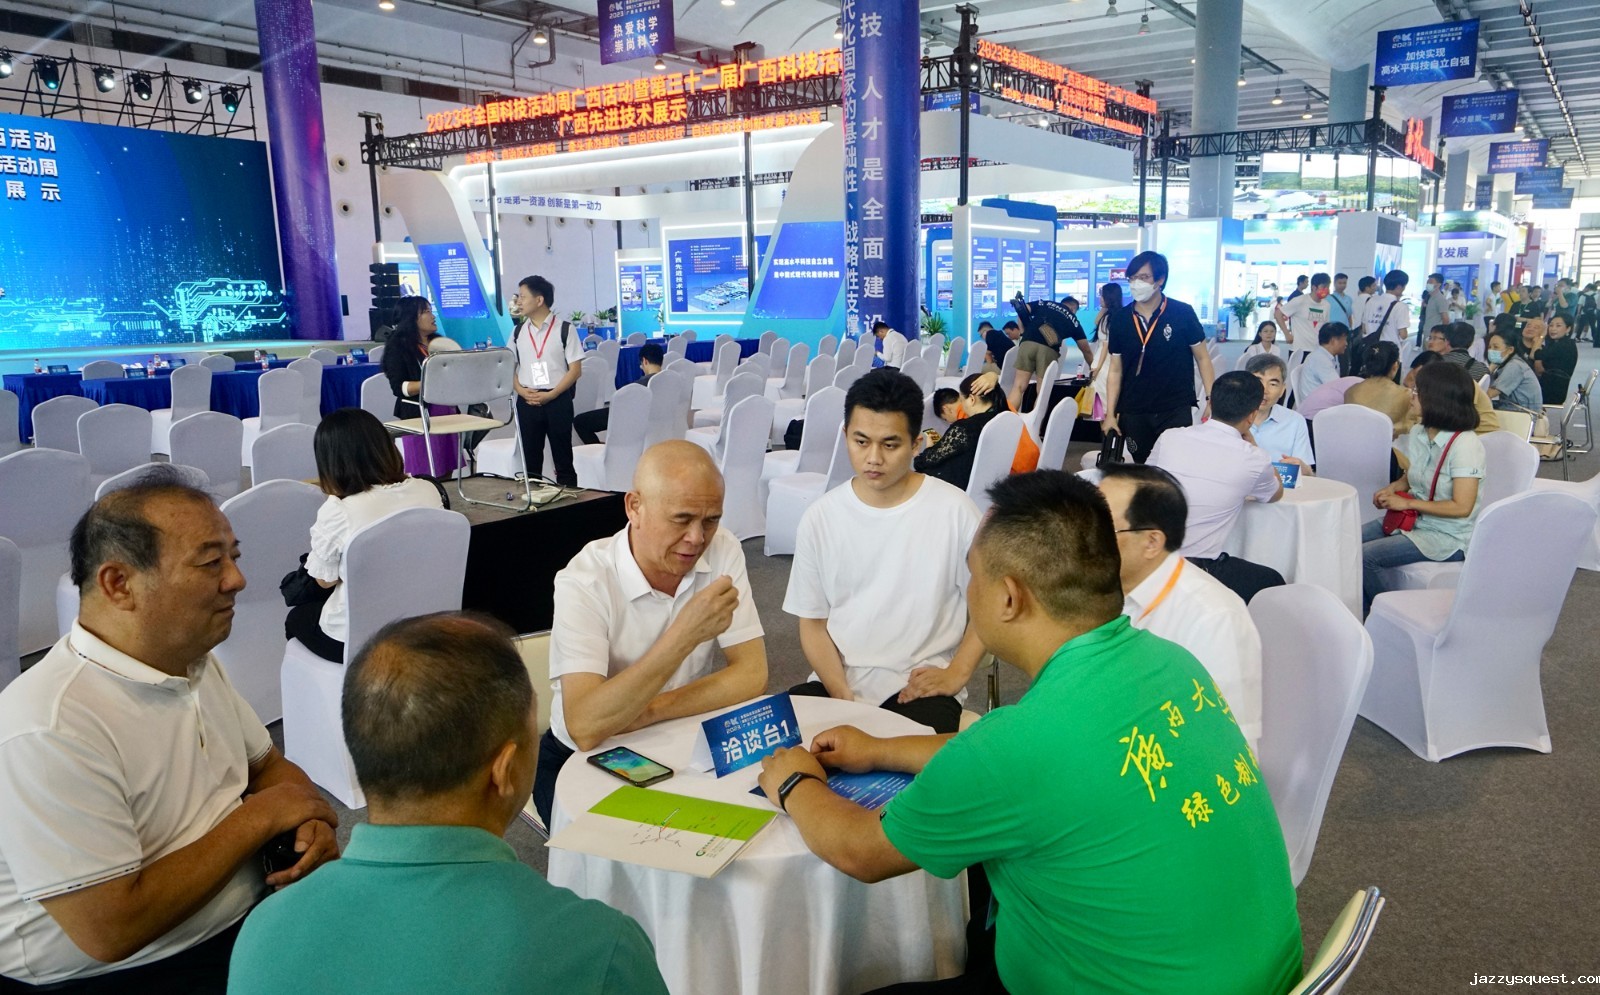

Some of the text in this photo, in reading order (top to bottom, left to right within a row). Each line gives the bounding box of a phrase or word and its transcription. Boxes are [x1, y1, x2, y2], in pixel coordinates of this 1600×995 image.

[609, 10, 624, 19] 2023
[860, 12, 883, 38] 技
[613, 15, 658, 38] 热爱科学
[614, 32, 659, 53] 崇尚科学
[1405, 47, 1446, 61] 加快实现
[1381, 55, 1470, 76] 高水平科技自立自强
[558, 97, 688, 137] 广西先进技术展示
[721, 719, 790, 765] 洽谈台1
